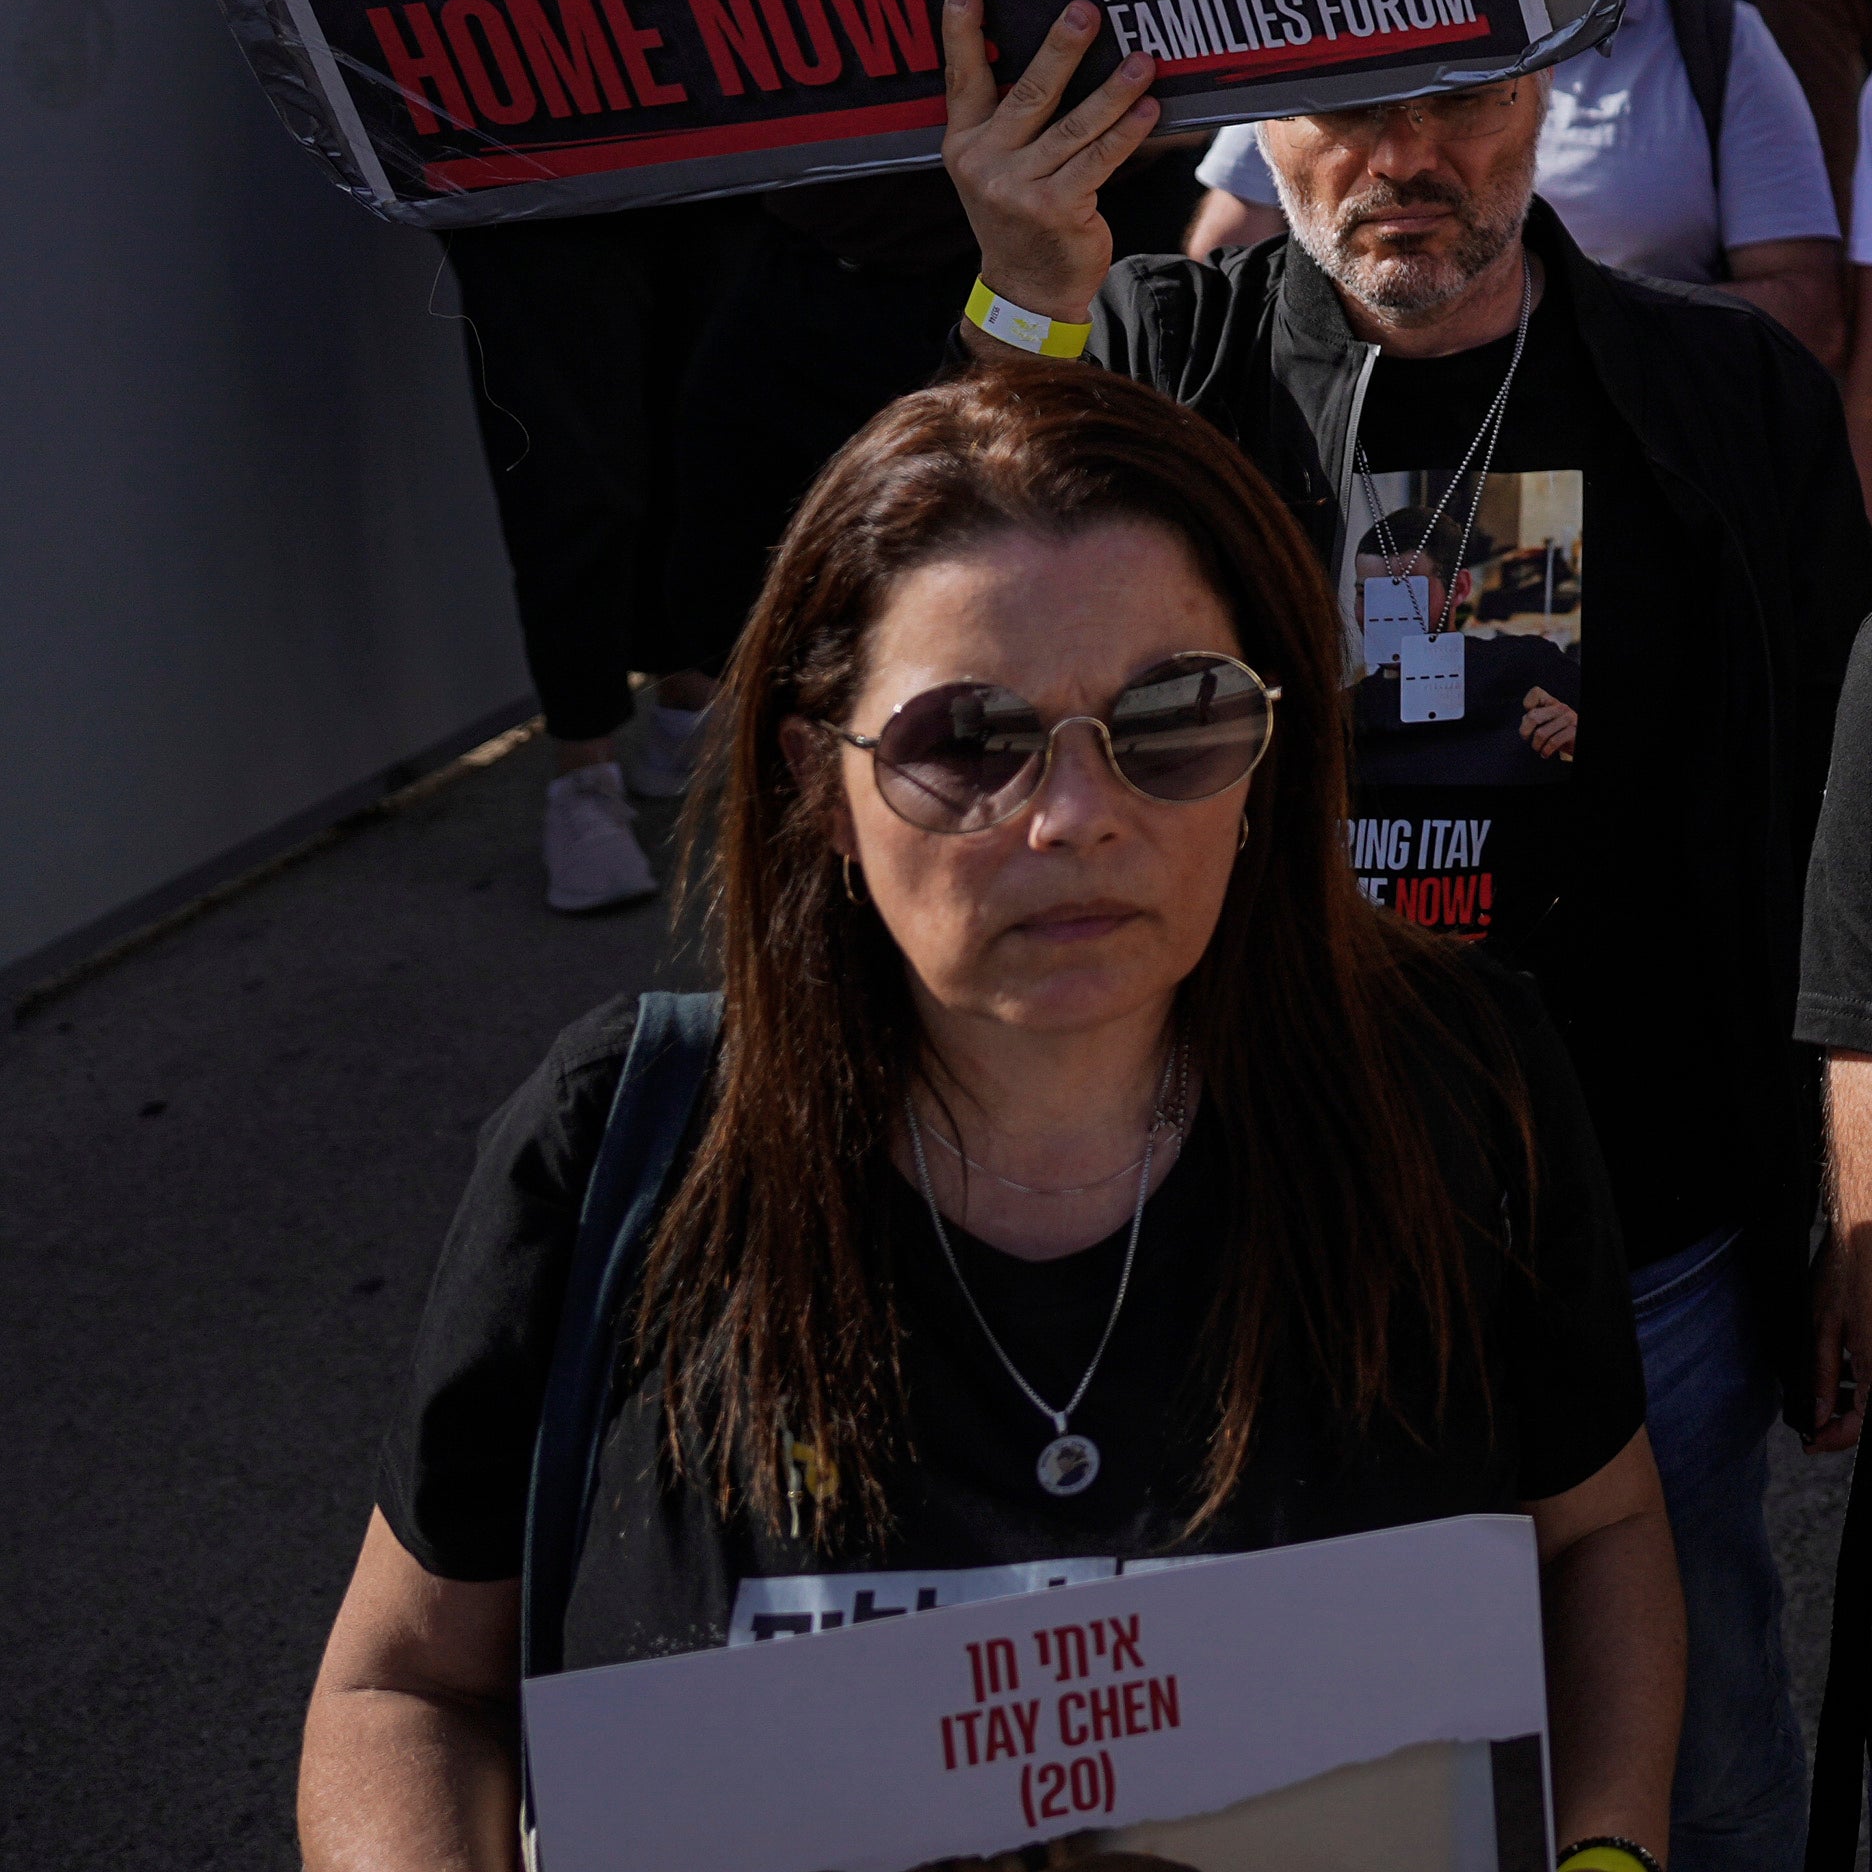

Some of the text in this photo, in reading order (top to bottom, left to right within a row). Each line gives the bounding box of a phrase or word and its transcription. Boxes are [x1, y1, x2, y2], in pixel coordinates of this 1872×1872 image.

[1417, 819, 1492, 870] ITAY
[1395, 873, 1493, 926] NOW!
[965, 1636, 1020, 1704] חן
[1033, 1612, 1145, 1683] איתי
[940, 1674, 1182, 1771] ITAY CHEN
[1020, 1749, 1117, 1828] (20)
